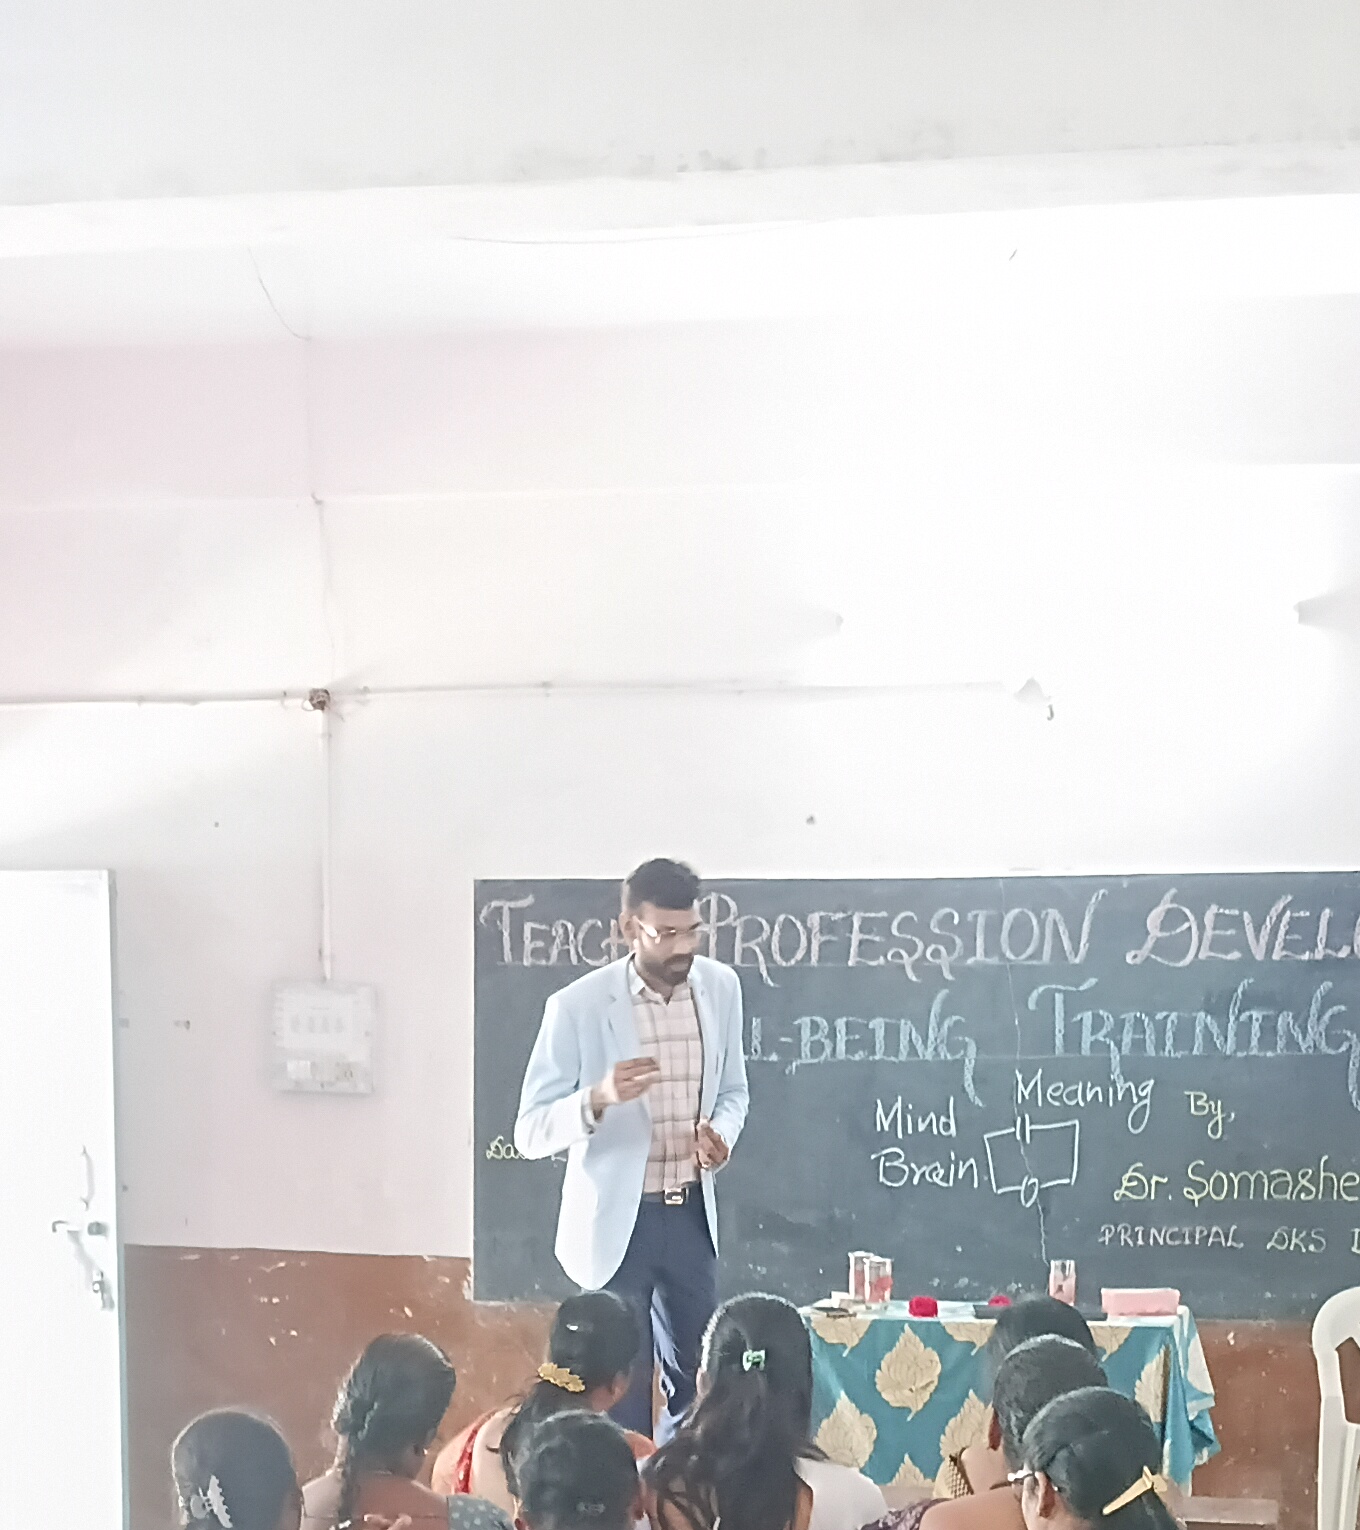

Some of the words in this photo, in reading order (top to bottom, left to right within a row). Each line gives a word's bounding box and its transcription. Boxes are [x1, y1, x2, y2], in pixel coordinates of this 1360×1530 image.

[692, 889, 1107, 987] PROFESSION
[875, 1095, 957, 1139] Mind
[1014, 1068, 1155, 1134] Meaning
[870, 1146, 980, 1189] Brain
[1113, 1161, 1173, 1203] Dr.
[1098, 1223, 1244, 1251] PRINCIPAL
